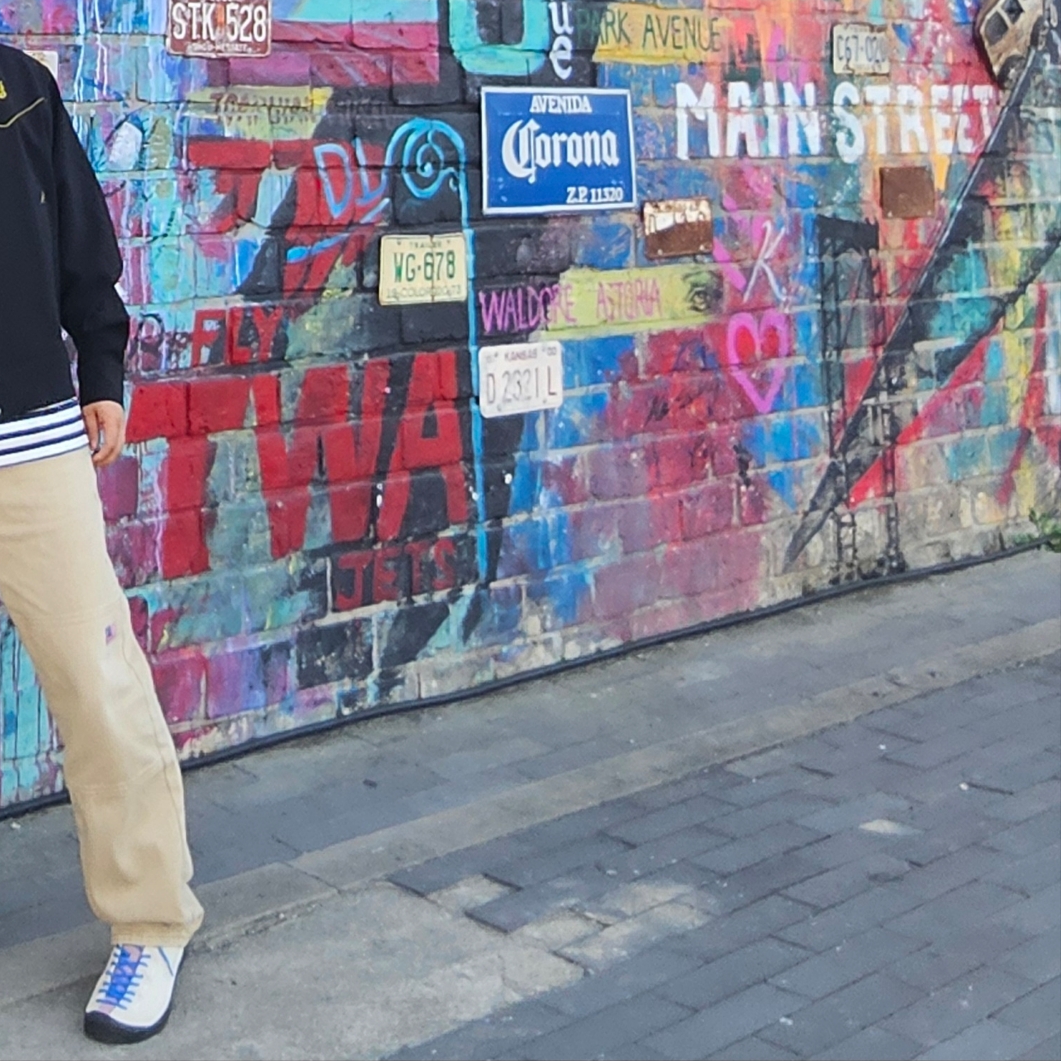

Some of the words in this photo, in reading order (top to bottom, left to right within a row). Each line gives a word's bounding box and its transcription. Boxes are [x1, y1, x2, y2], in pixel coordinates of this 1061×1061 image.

[577, 7, 632, 47] PARK
[641, 12, 723, 53] AVENUE
[529, 94, 593, 114] AVENIDA
[675, 80, 821, 161] MAIN
[832, 80, 998, 164] STREET
[501, 117, 621, 185] Corona
[190, 305, 285, 367] FLY
[504, 348, 538, 361] KANSAS
[126, 350, 469, 579] TWA
[334, 536, 456, 611] JETS
